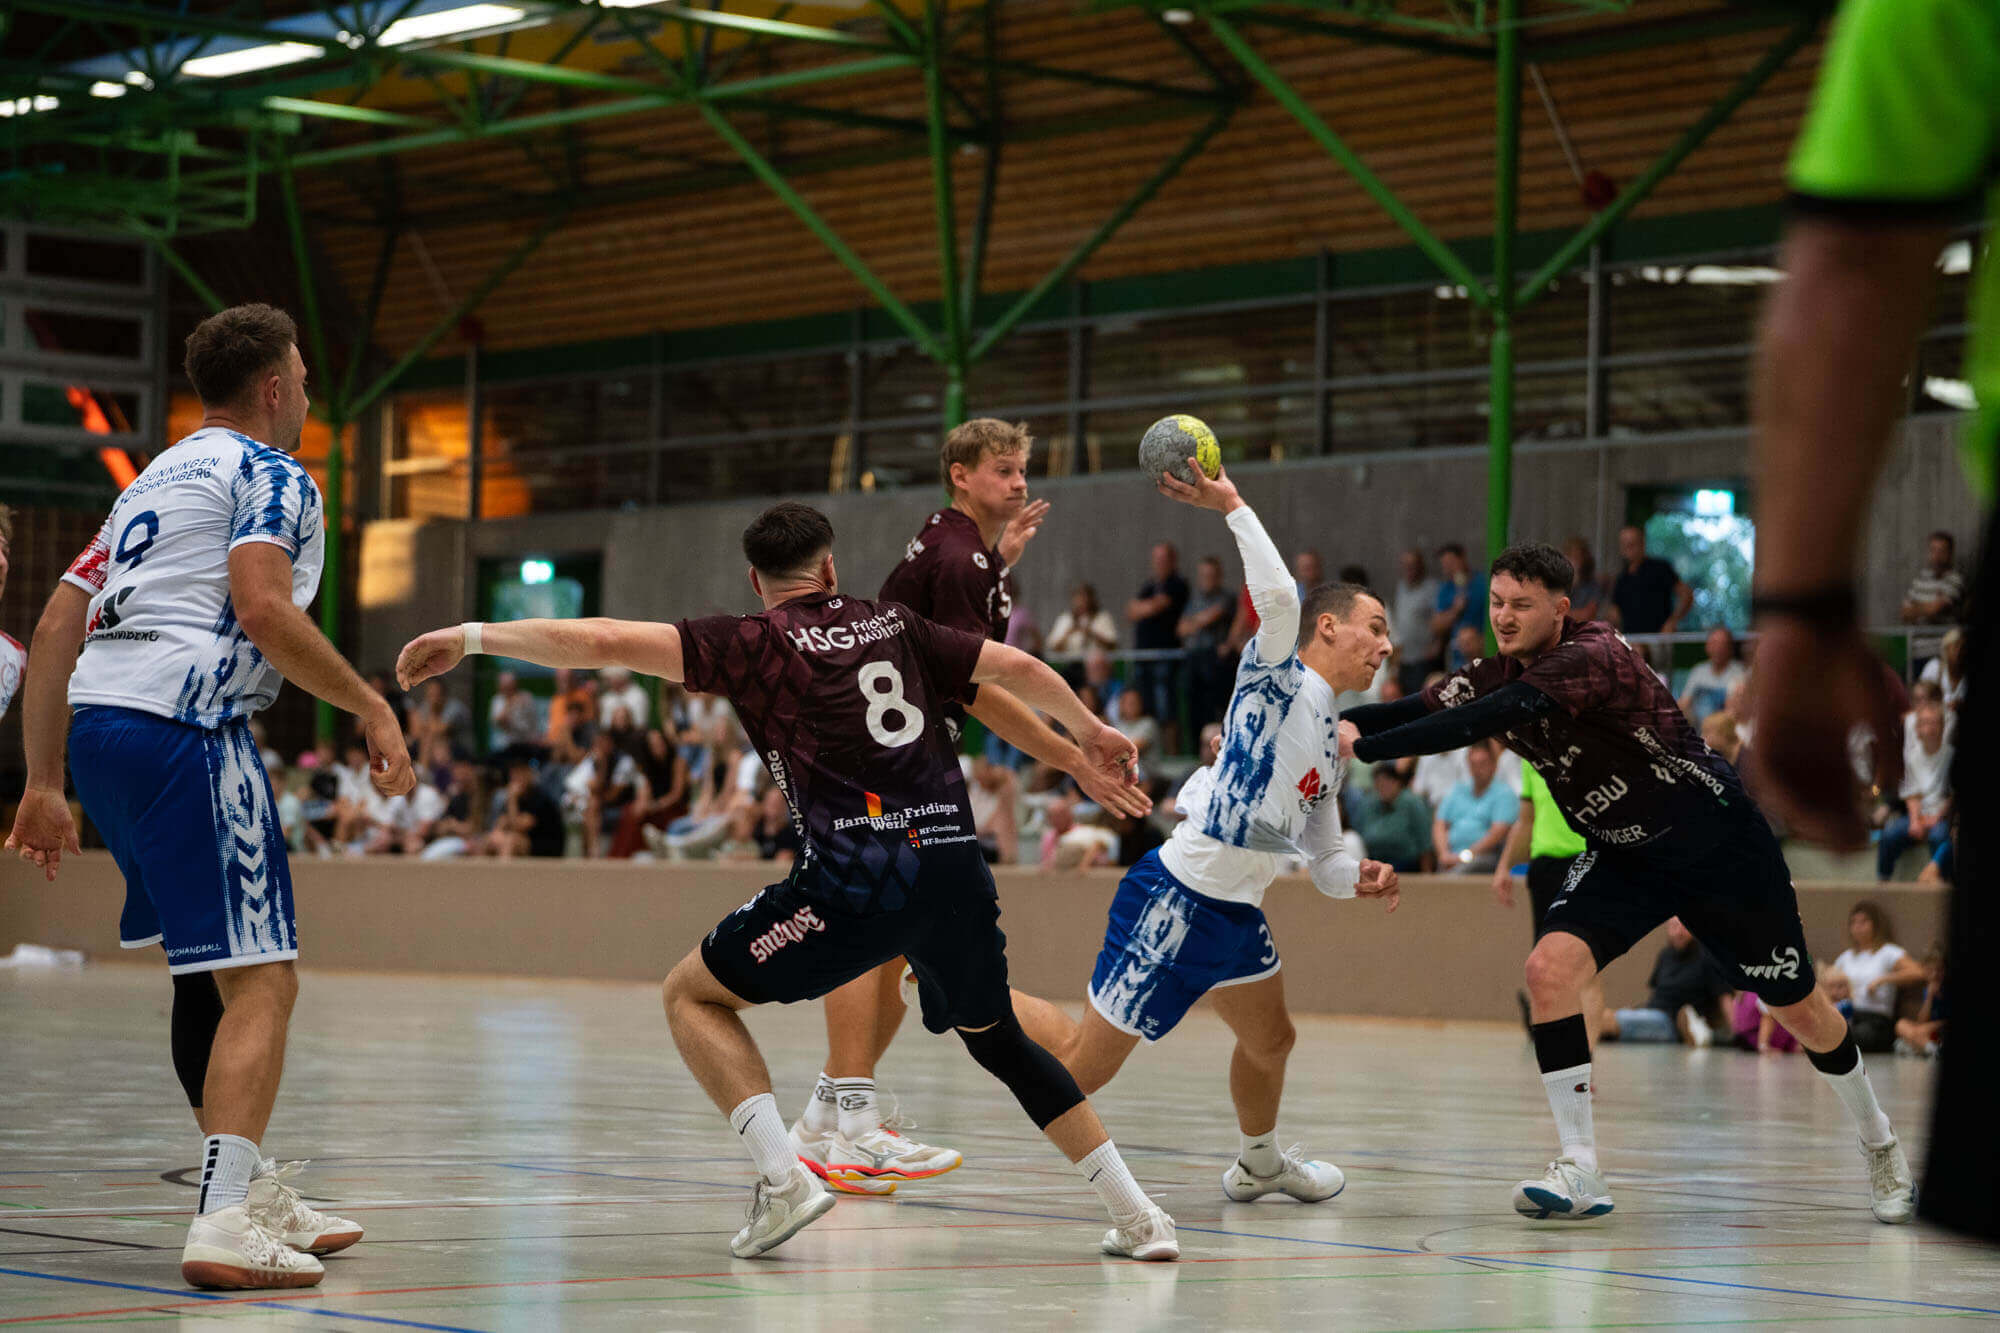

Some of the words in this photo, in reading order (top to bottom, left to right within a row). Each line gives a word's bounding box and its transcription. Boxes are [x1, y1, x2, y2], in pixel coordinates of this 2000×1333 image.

[115, 510, 159, 573] 9
[786, 626, 855, 651] HSG
[858, 661, 925, 748] 8
[833, 812, 900, 832] Hammer
[904, 802, 959, 818] Fridingen
[870, 815, 910, 831] Werk
[1258, 923, 1277, 967] 3
